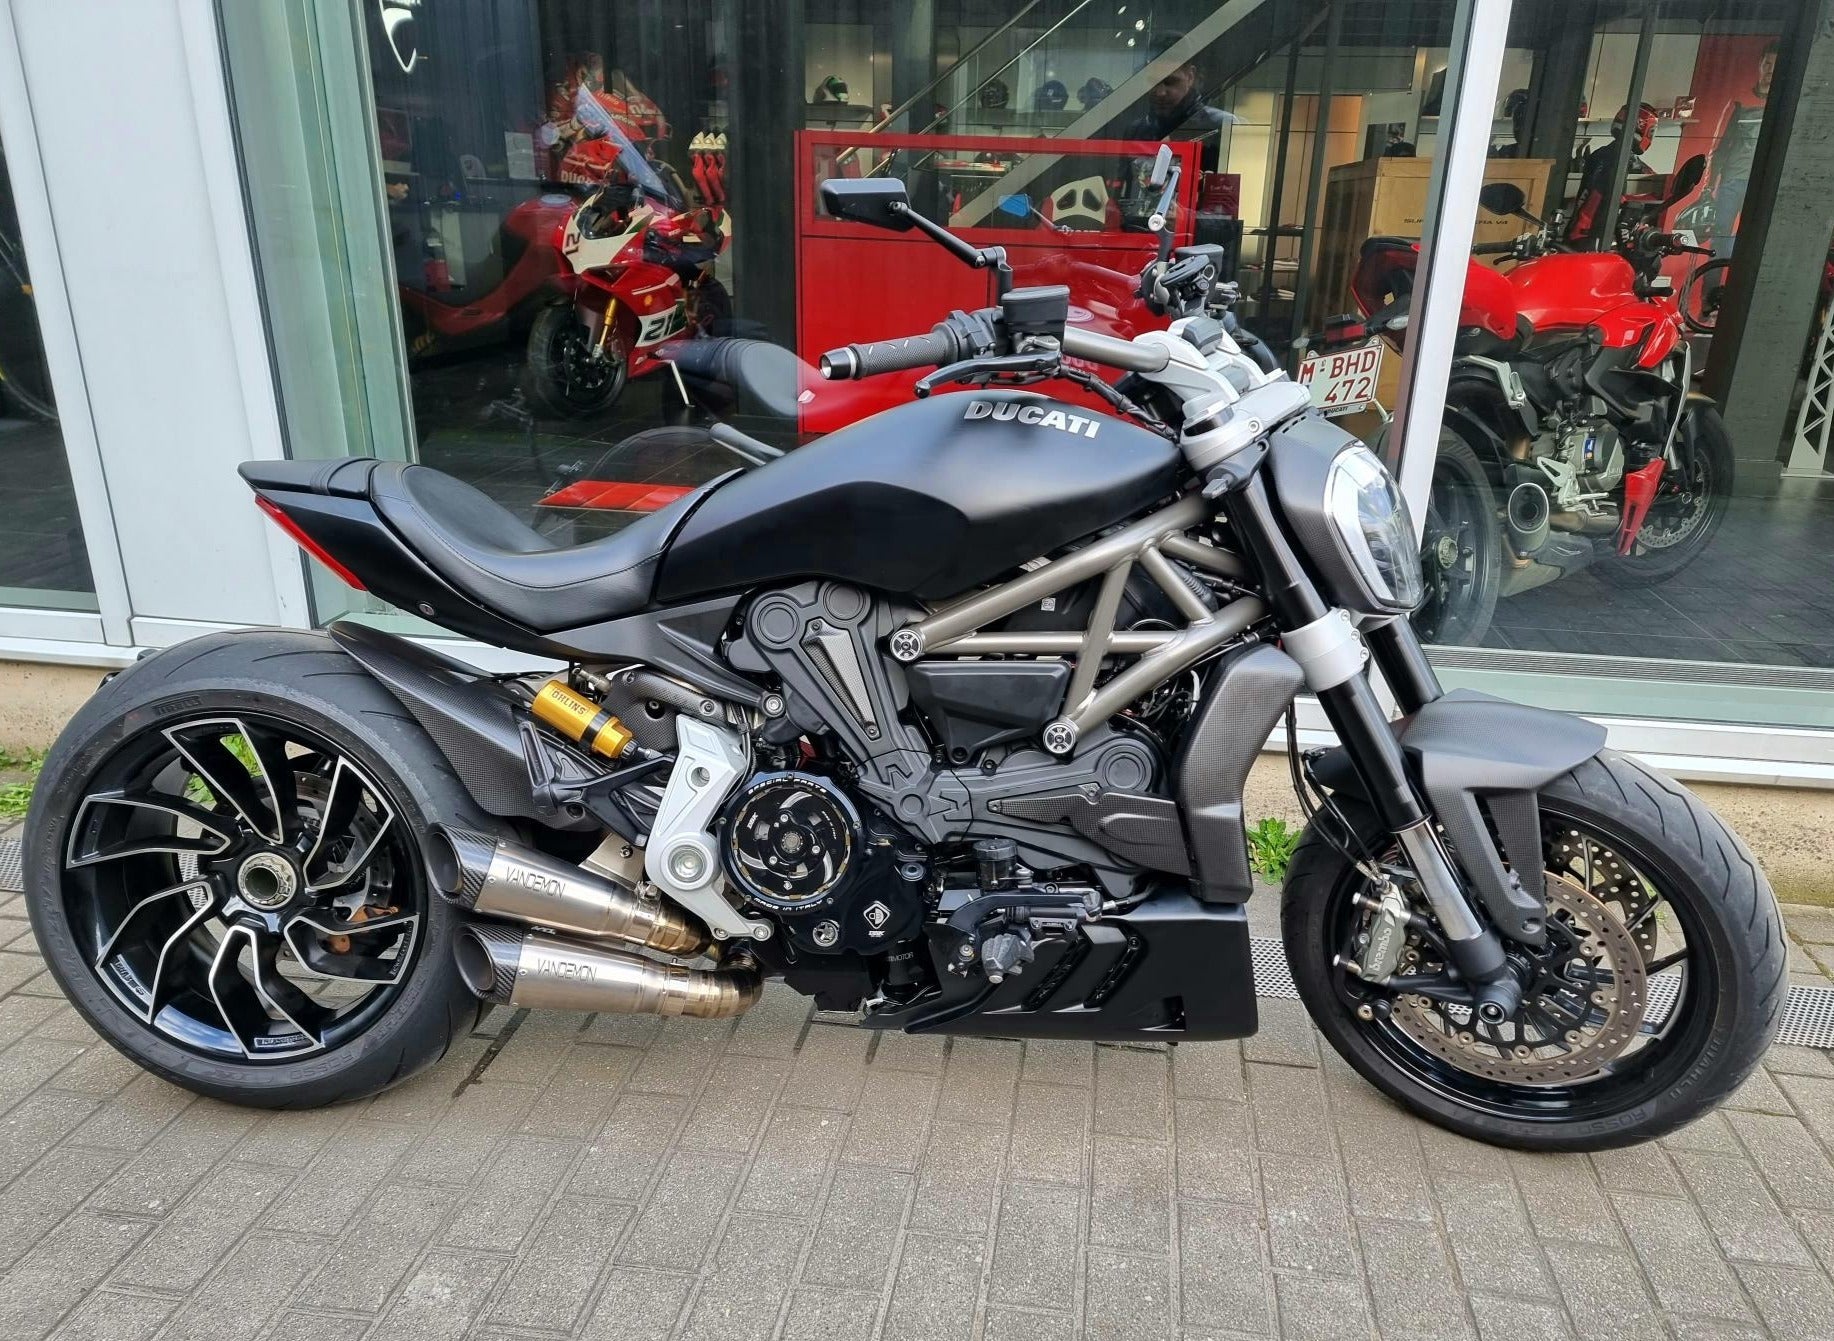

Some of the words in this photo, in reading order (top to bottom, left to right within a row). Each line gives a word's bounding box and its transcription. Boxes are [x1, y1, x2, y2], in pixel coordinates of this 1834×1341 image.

[1324, 376, 1371, 403] 472
[964, 400, 1101, 438] DUCATI
[794, 778, 827, 793] PARTS
[506, 866, 566, 899] VANDEMON
[1369, 927, 1392, 971] brembo
[537, 958, 598, 981] VANDEMON
